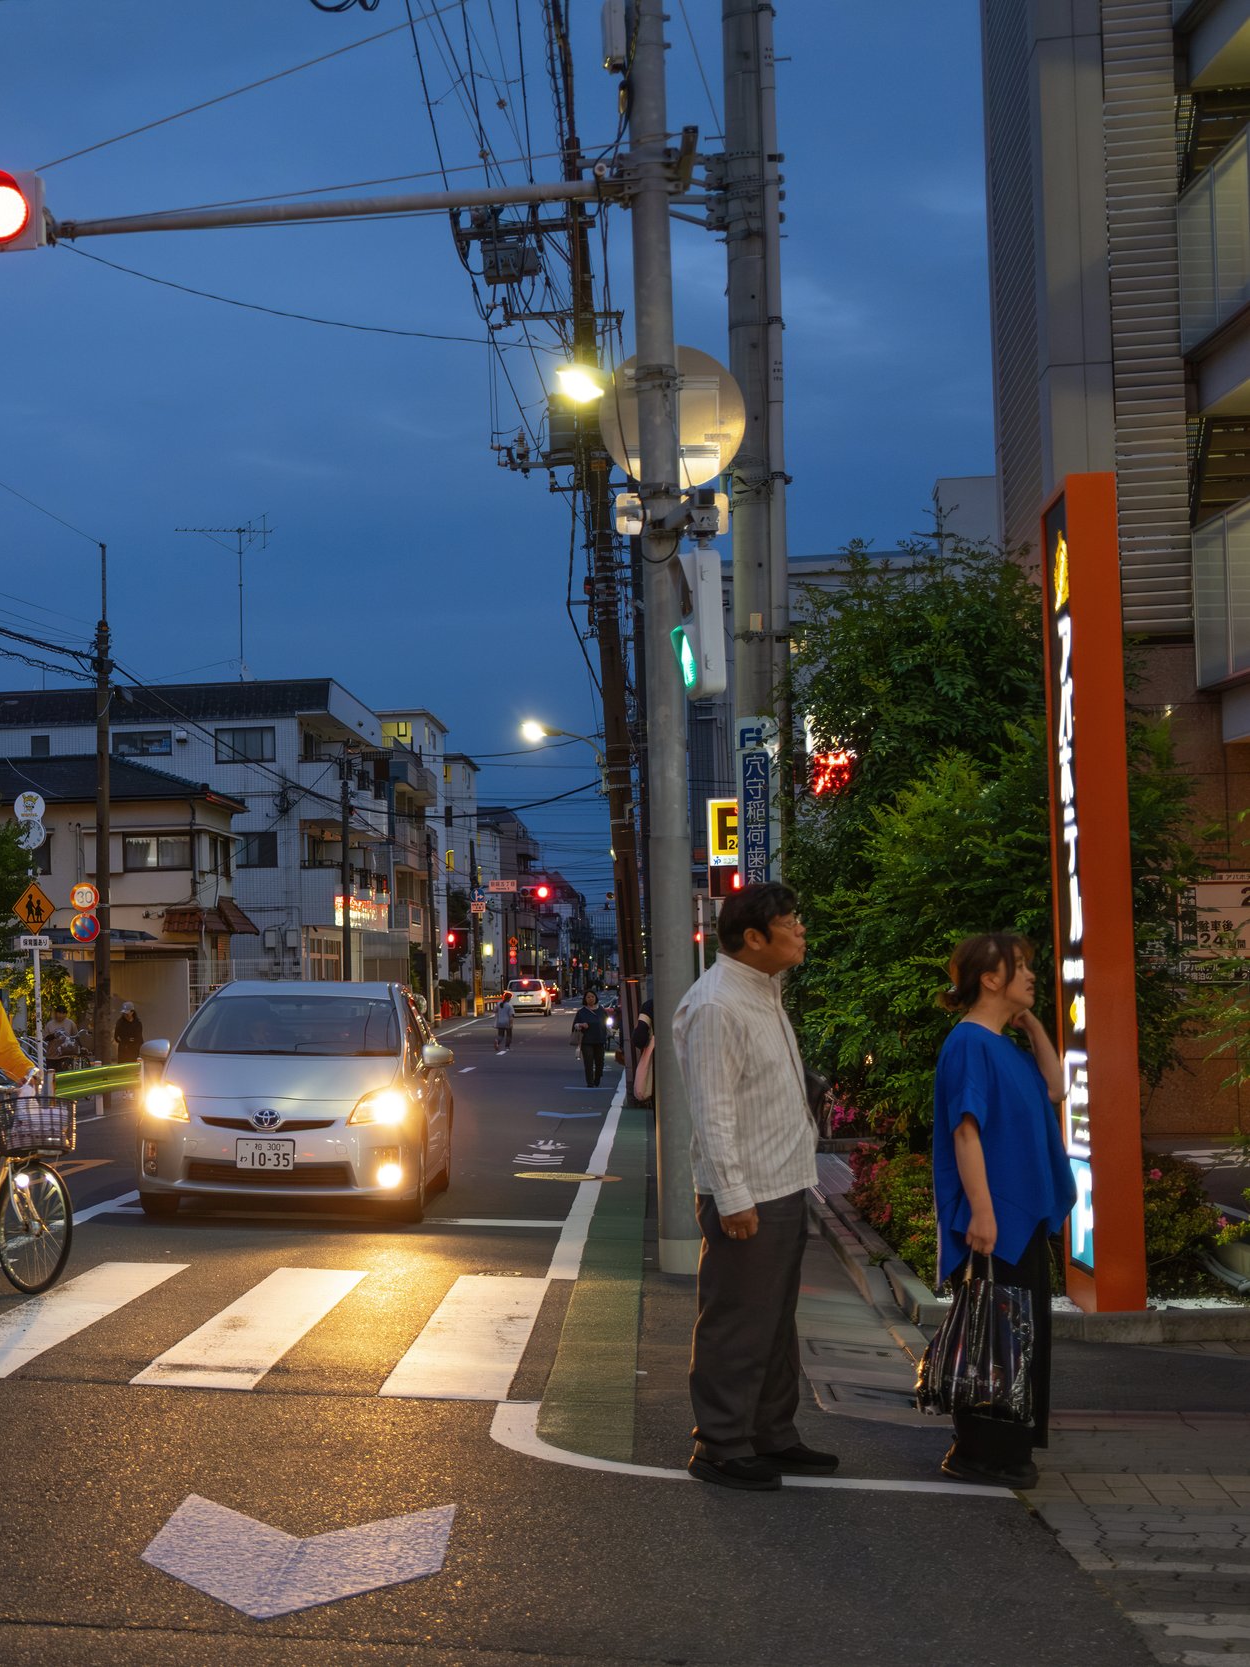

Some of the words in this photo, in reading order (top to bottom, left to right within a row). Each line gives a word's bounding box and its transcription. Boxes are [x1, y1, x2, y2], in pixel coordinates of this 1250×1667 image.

[76, 890, 93, 904] 30
[22, 938, 48, 947] 保育園あり
[252, 1152, 290, 1167] 10-35
